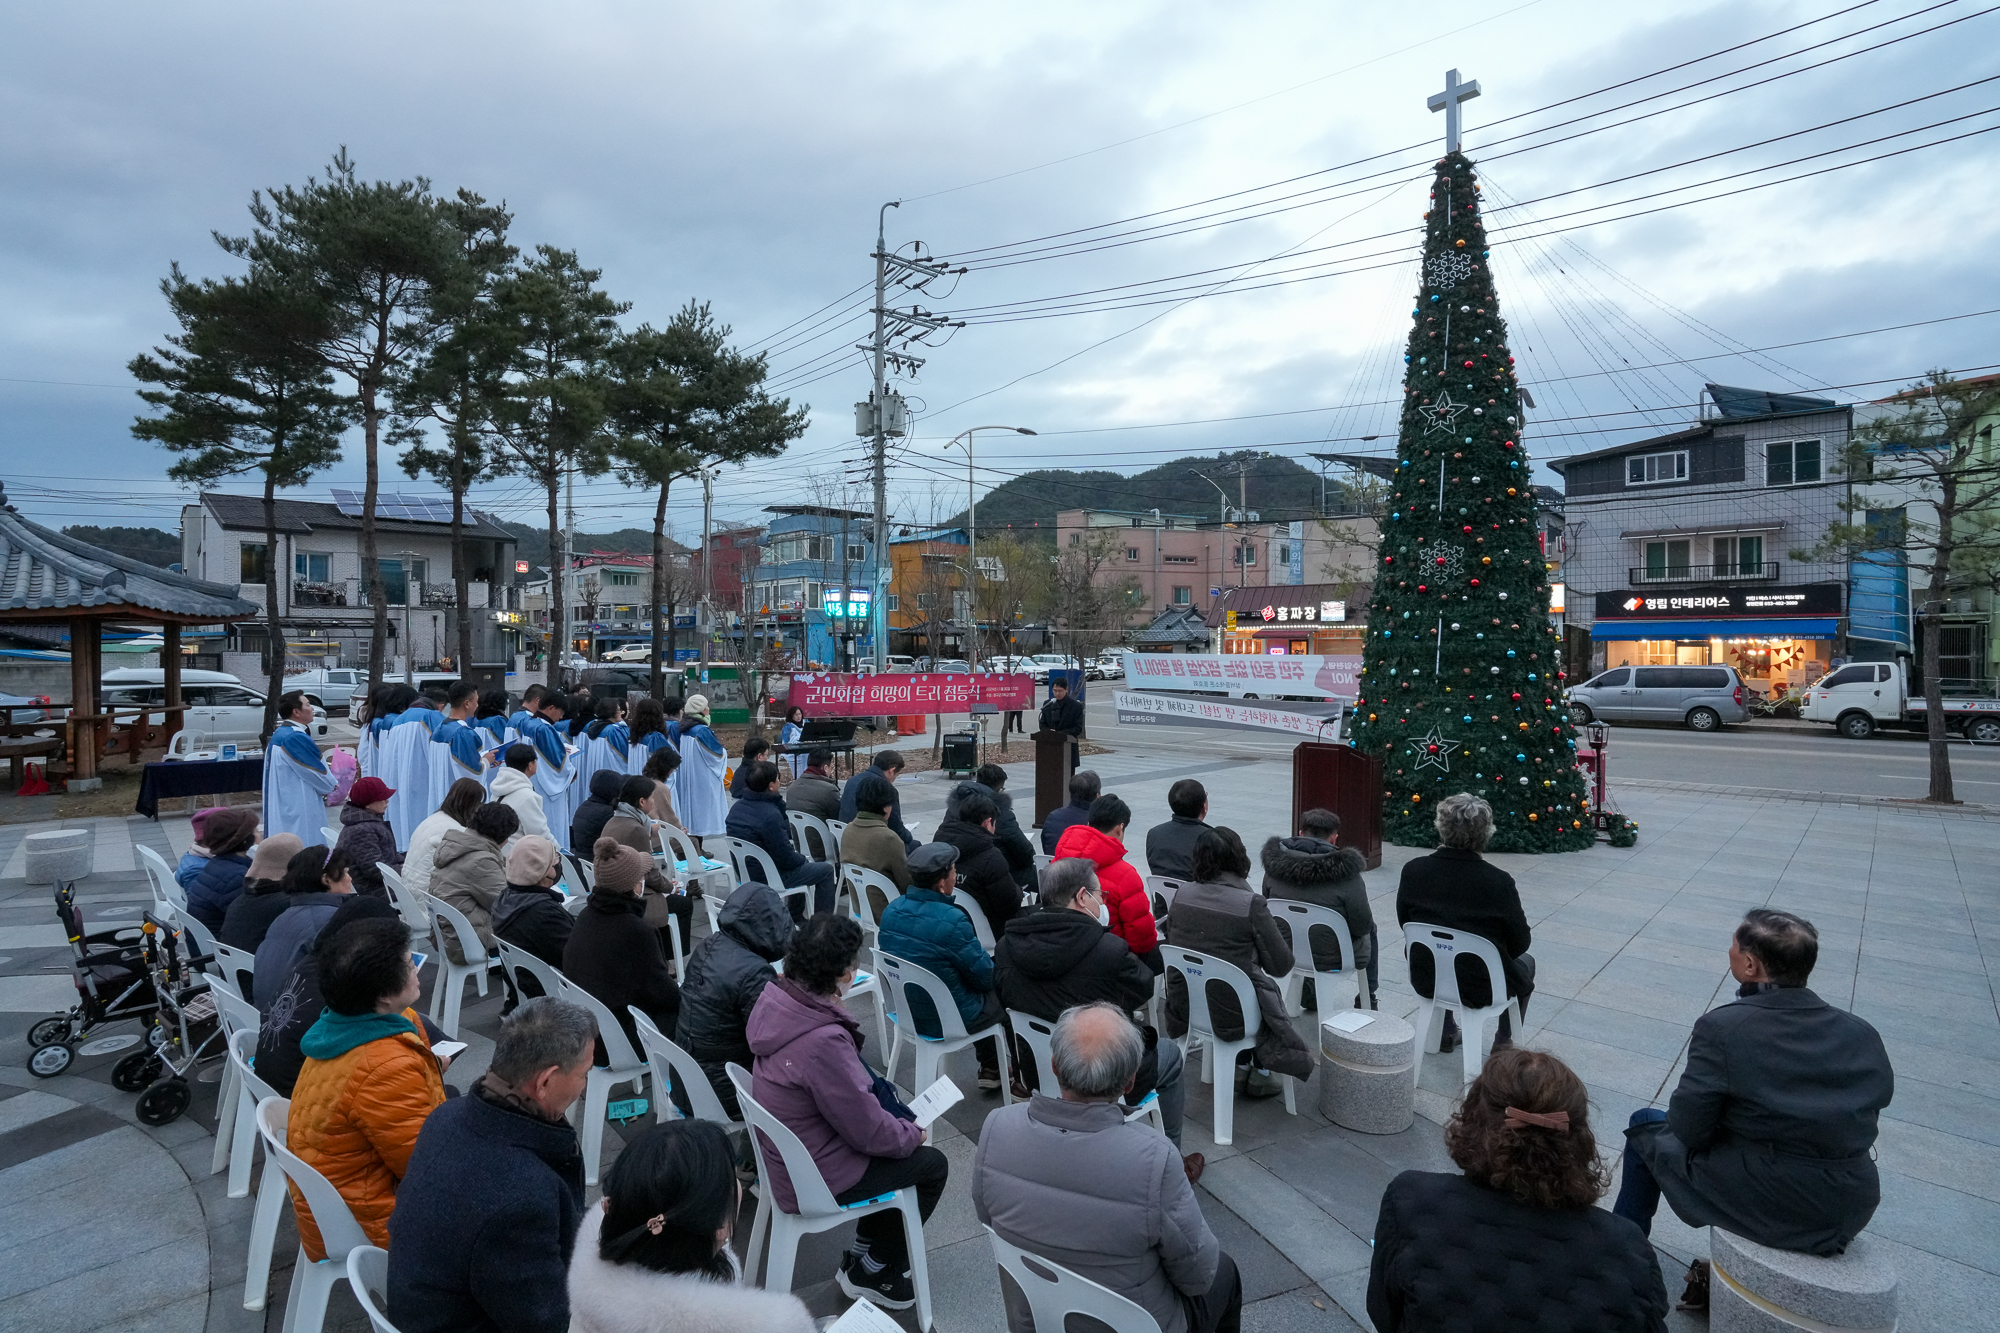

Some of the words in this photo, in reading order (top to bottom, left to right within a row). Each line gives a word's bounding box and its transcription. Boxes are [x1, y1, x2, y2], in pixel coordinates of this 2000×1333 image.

[1645, 598, 1668, 609] 영림
[1670, 596, 1731, 609] 인테리어스
[806, 685, 867, 704] 군민화합
[870, 685, 911, 703] 희망의
[916, 685, 941, 702] 트리
[944, 685, 980, 701] 점등식
